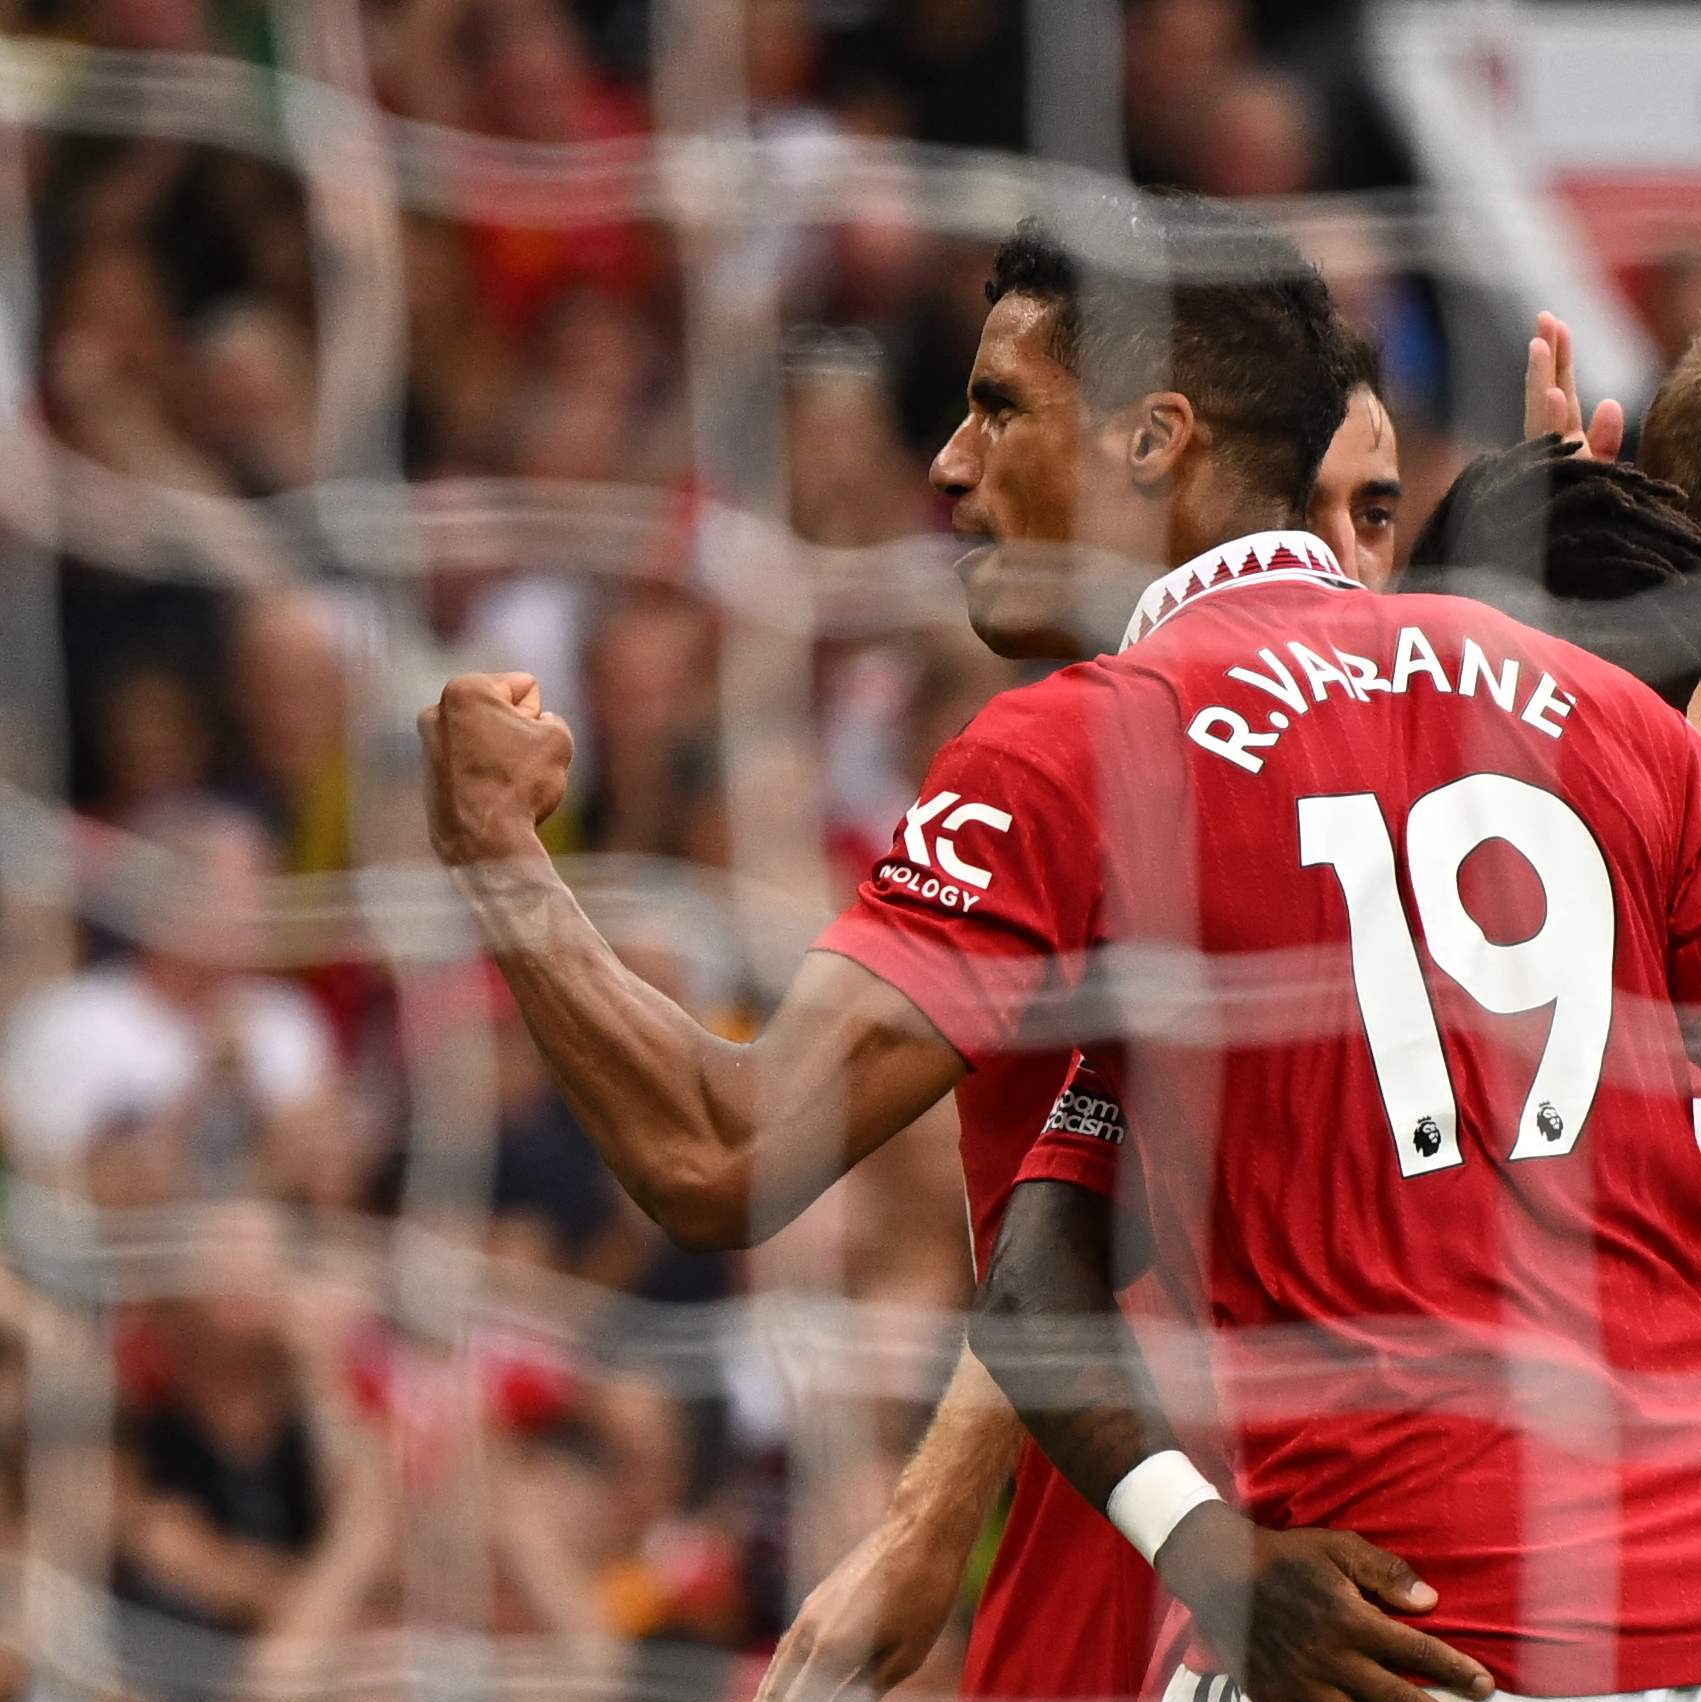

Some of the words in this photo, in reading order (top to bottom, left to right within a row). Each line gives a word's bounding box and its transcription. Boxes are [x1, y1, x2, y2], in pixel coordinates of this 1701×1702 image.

[1187, 626, 1577, 774] R.VARANE
[878, 864, 981, 913] NOLOGY
[903, 790, 1014, 890] XC
[1296, 772, 1615, 1179] 19
